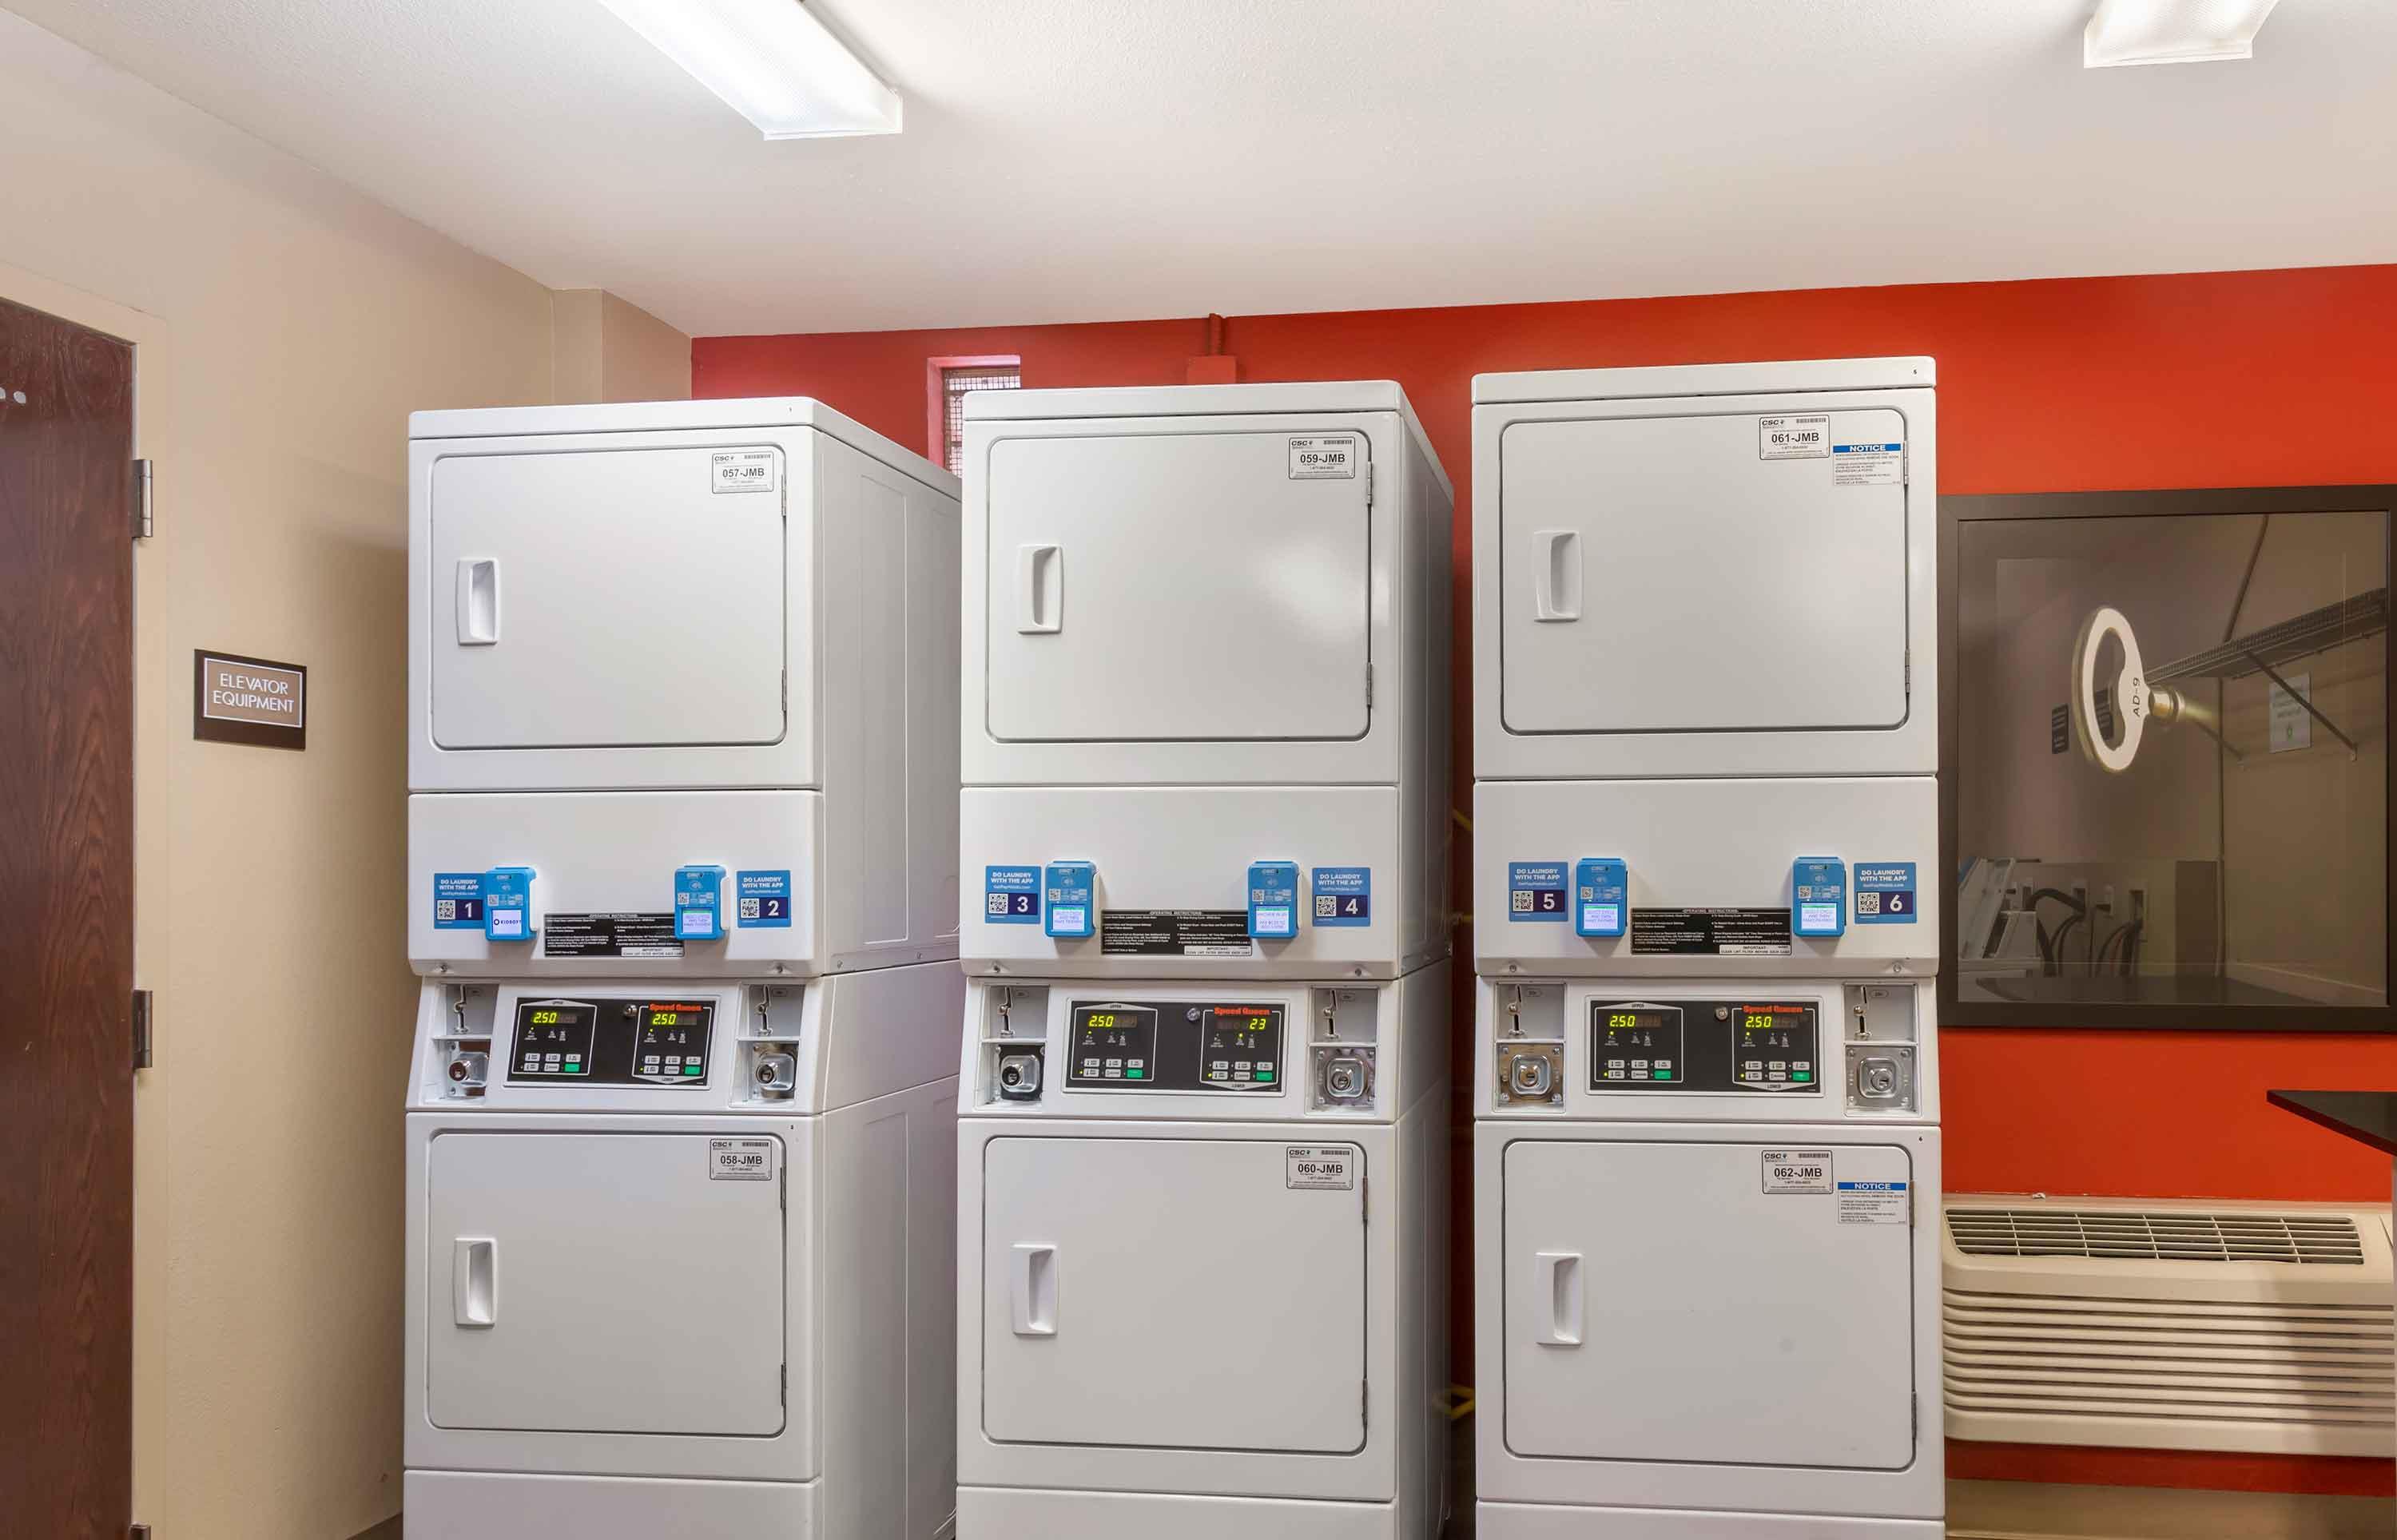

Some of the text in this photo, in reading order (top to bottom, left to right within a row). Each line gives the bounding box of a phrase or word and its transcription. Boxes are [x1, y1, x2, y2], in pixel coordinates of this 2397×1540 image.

[1771, 432, 1819, 443] 061-JMB
[1300, 454, 1346, 463] 059-JMB
[722, 467, 765, 478] 057-JMB
[220, 673, 288, 695] ELEVATOR
[213, 690, 295, 713] EQUIPMENT
[1017, 895, 1029, 913] 3
[1345, 898, 1358, 915] 4
[1543, 893, 1555, 910] 5
[1890, 894, 1903, 912] 6
[464, 902, 472, 919] 1
[767, 900, 779, 916] 2
[1214, 1006, 1270, 1016] Speed Queen
[1742, 1005, 1772, 1014] Speed
[533, 1012, 558, 1023] 2.50
[652, 1014, 677, 1025] 2.50
[1088, 1015, 1114, 1028] 2.50
[1609, 1015, 1636, 1028] 2.50
[1745, 1016, 1772, 1028] 2.50
[1249, 1018, 1266, 1030] 23
[720, 1155, 762, 1165] 058-JMB
[1298, 1163, 1343, 1173] 060-JMB
[1774, 1168, 1823, 1177] 062-JMB
